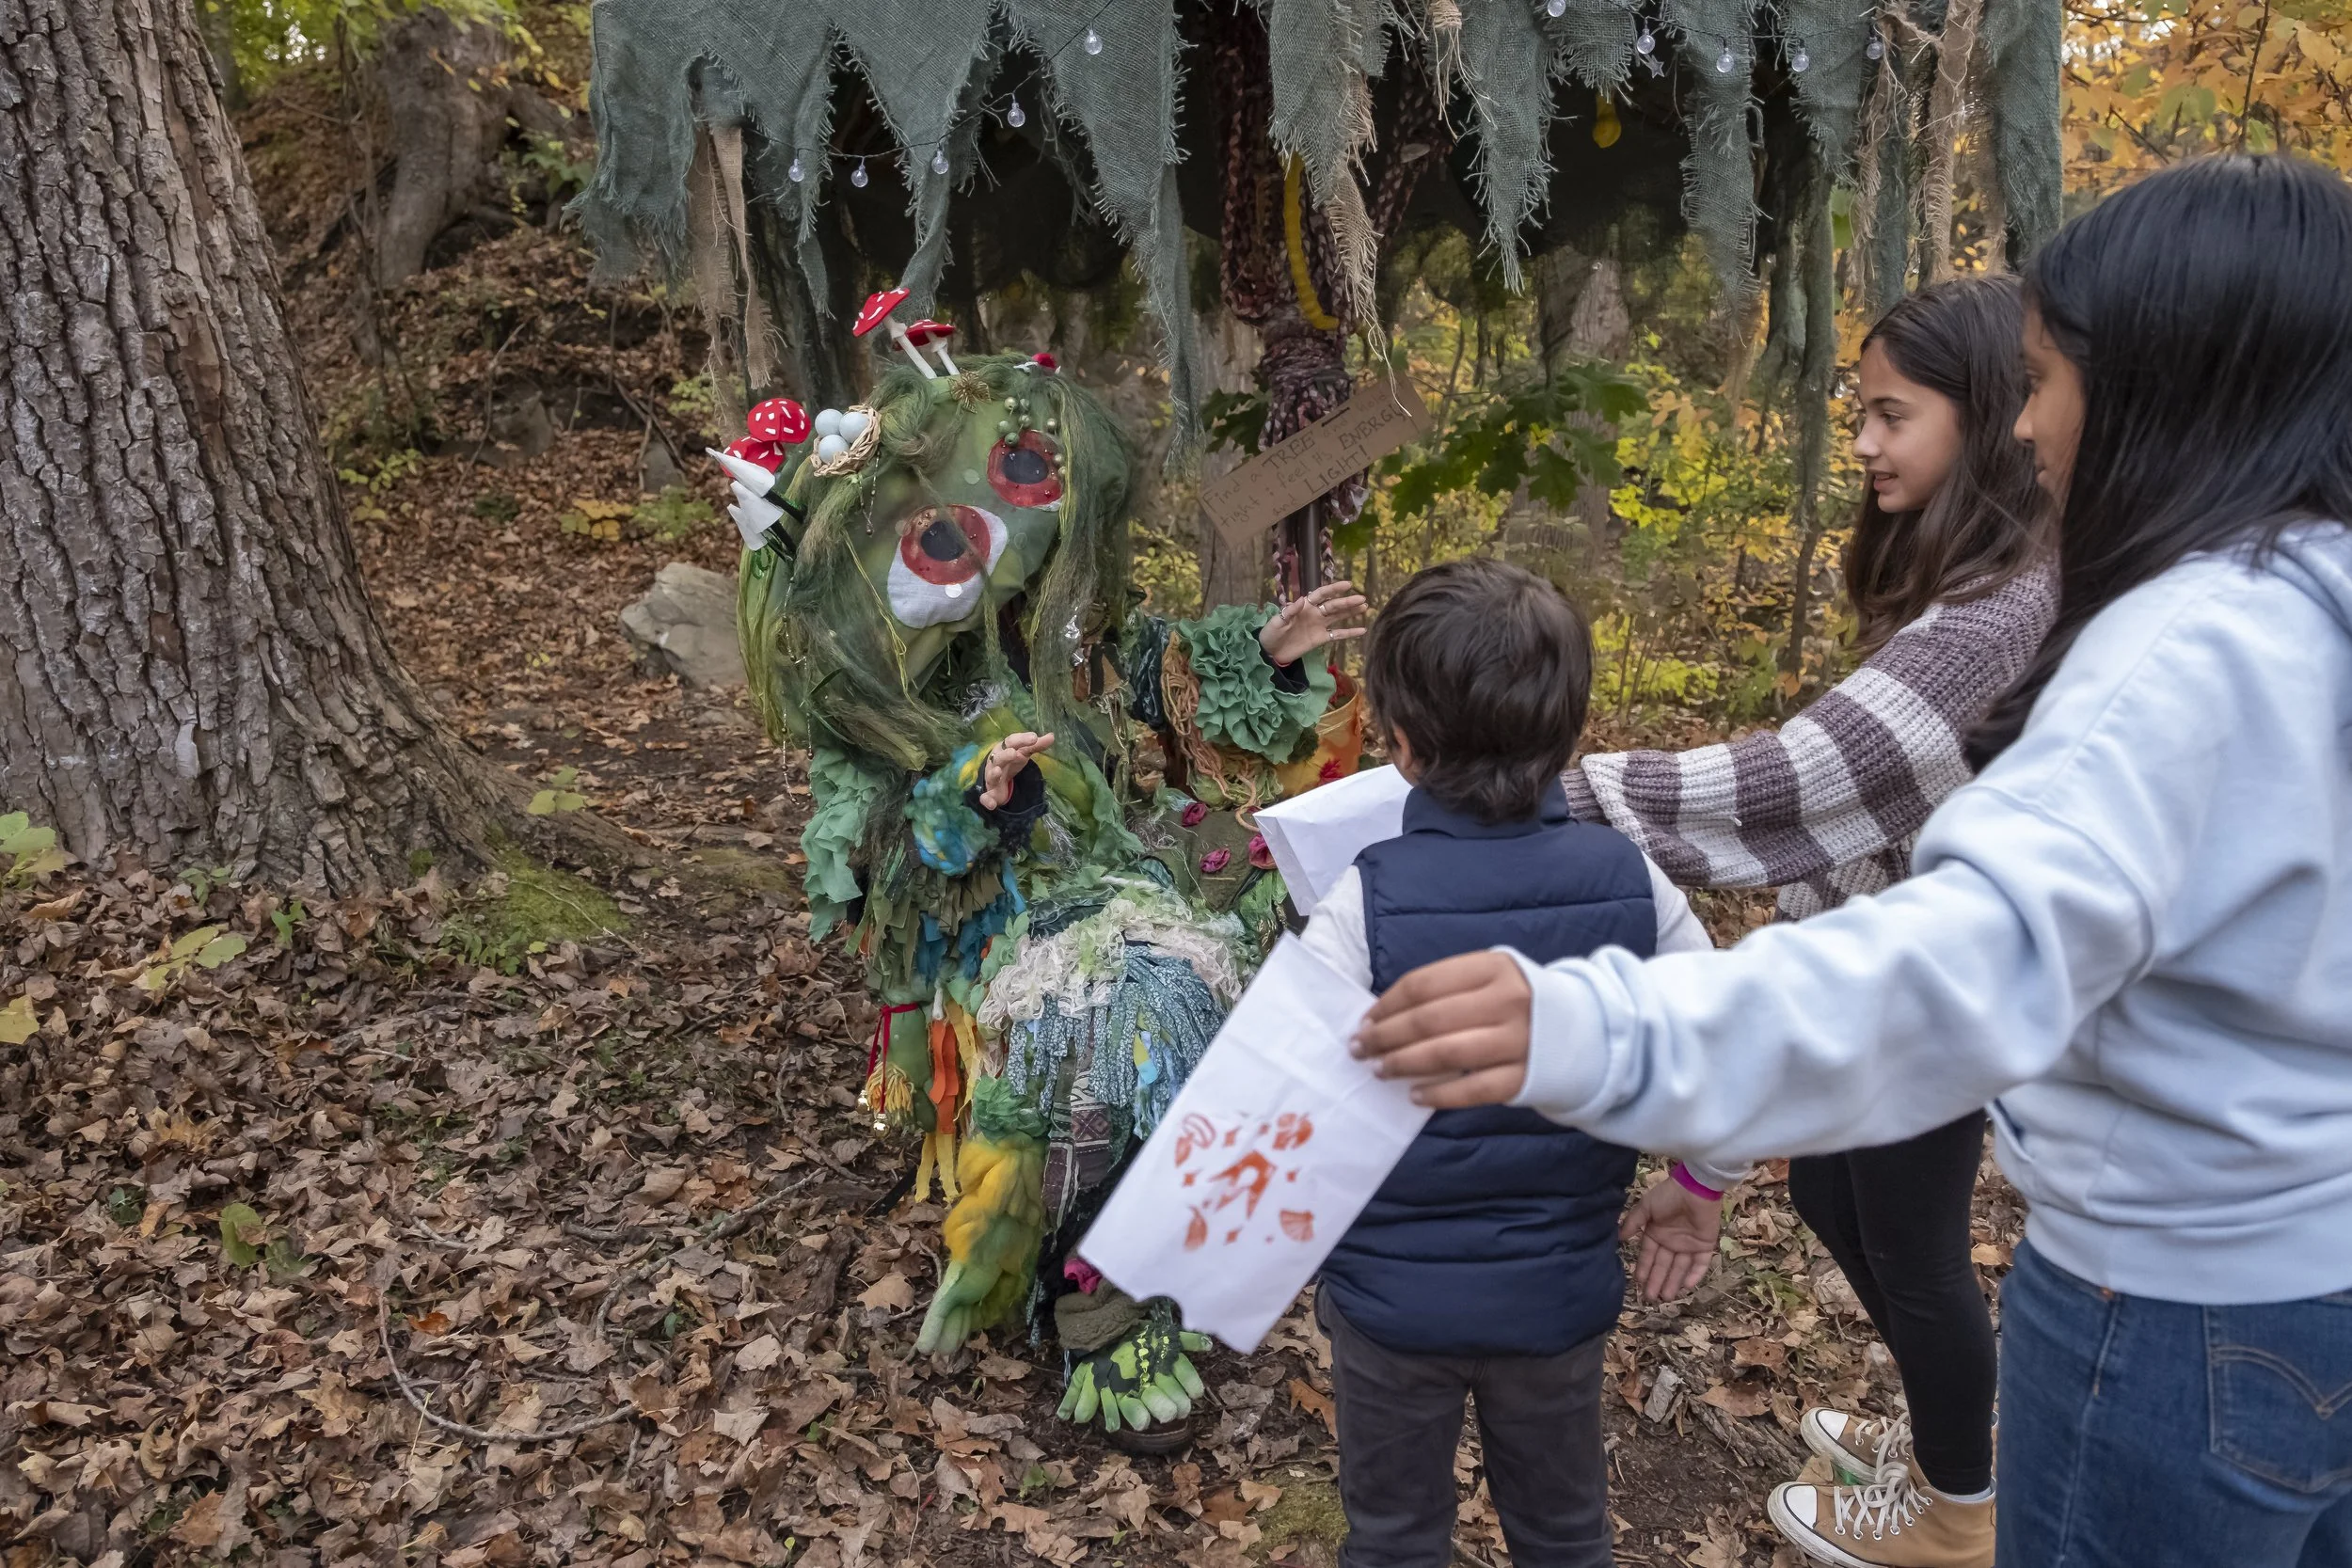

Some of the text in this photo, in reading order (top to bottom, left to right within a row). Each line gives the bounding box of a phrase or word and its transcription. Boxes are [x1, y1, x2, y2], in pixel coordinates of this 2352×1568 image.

[1201, 478, 1241, 514] Find
[1251, 472, 1263, 483] a
[1261, 430, 1316, 468] TREE
[1219, 496, 1262, 528] tight
[1277, 459, 1311, 489] feel
[1272, 443, 1372, 516] and LIGHT!
